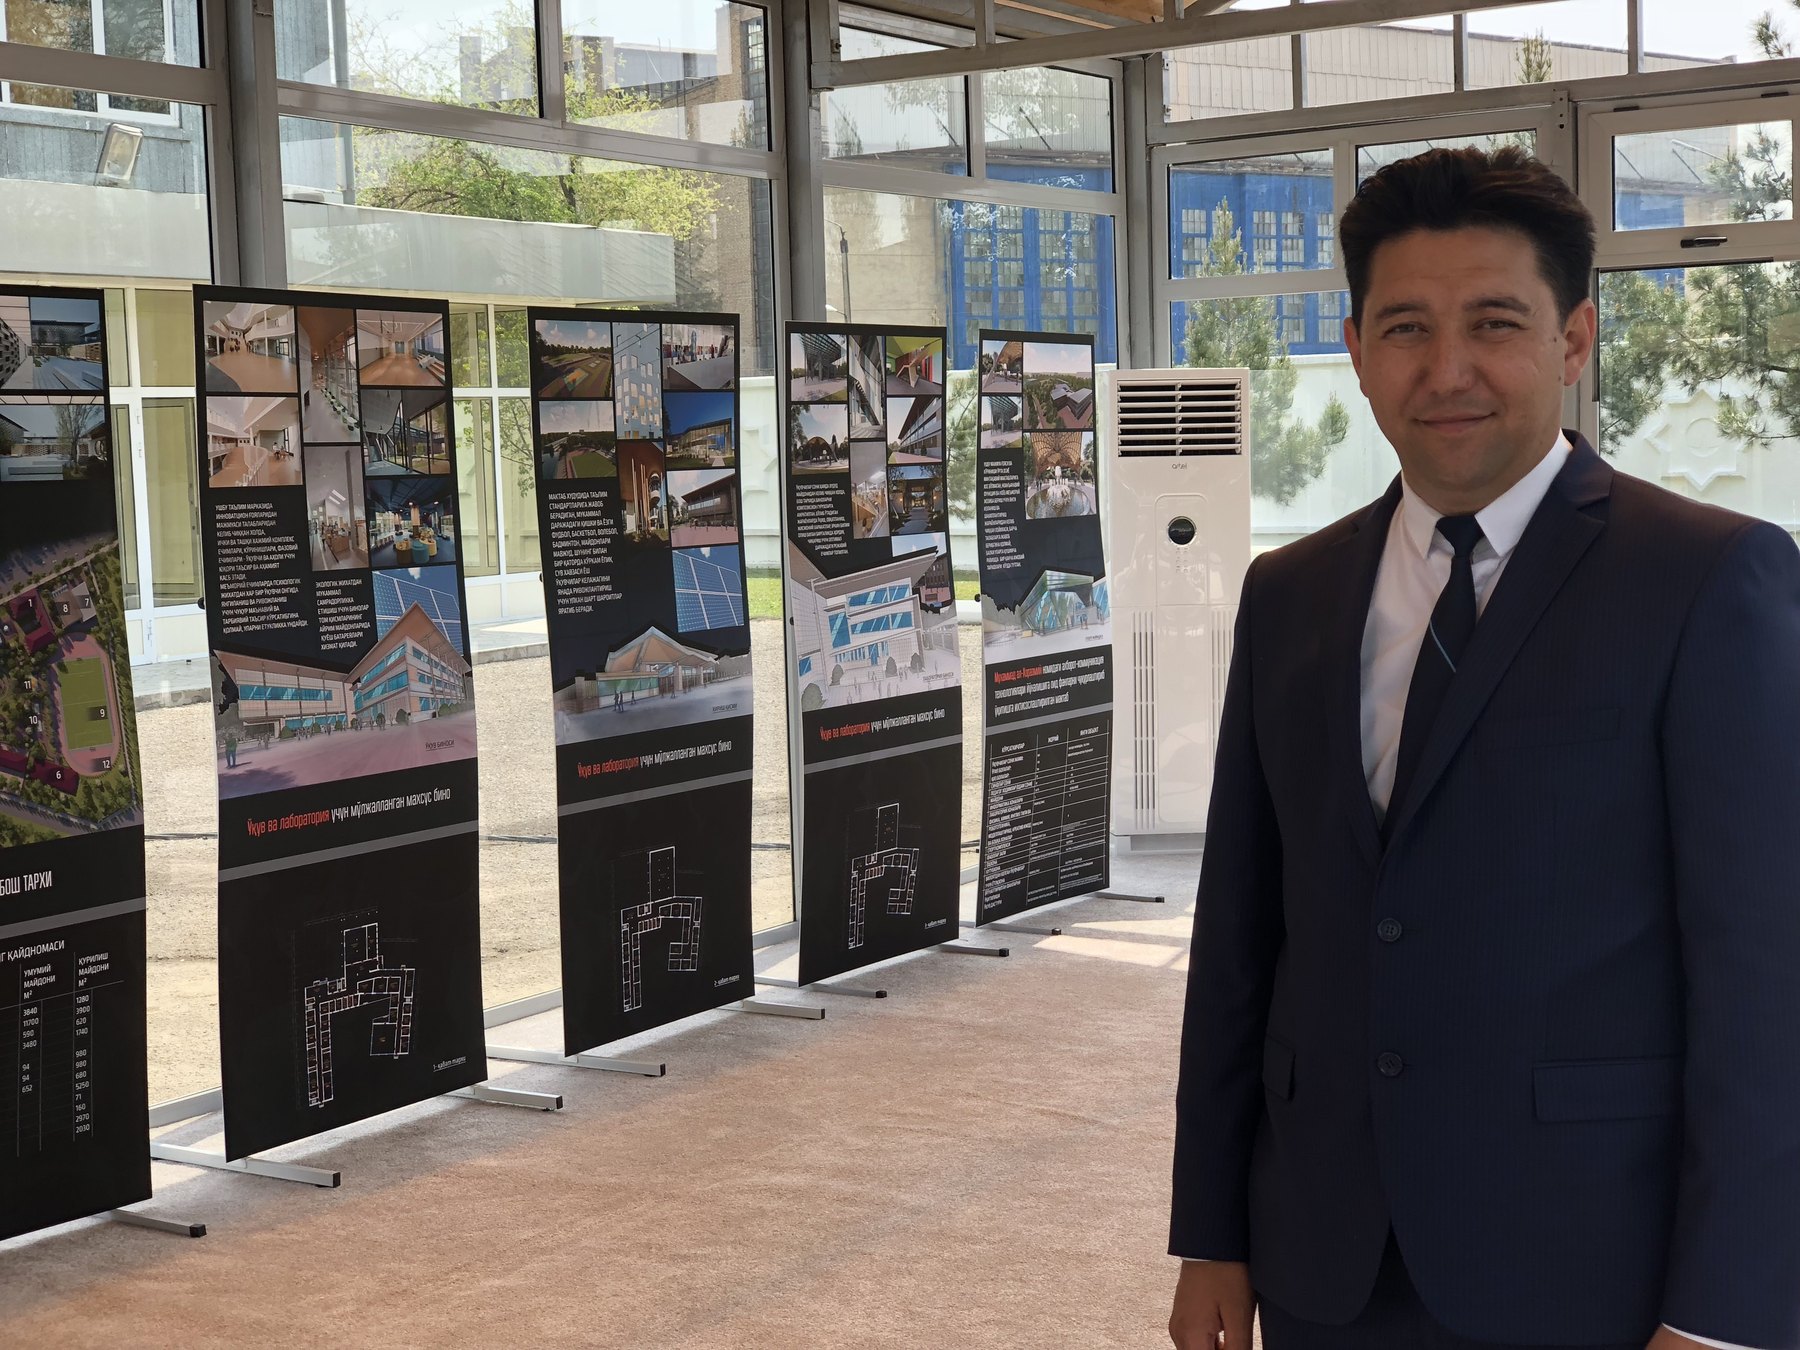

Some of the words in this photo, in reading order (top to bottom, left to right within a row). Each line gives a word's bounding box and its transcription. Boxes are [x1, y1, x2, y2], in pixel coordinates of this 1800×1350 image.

[28, 598, 33, 608] 1
[85, 598, 90, 607] 7
[62, 603, 69, 613] 8
[23, 680, 31, 689] 11
[100, 708, 105, 718] 9
[28, 715, 38, 725] 10
[833, 728, 839, 738] ва
[839, 722, 870, 736] лаборатория
[871, 720, 882, 733] учун
[934, 708, 945, 719] бино
[102, 760, 110, 769] 12
[577, 762, 592, 779] Ўқув
[593, 764, 601, 775] ва
[601, 757, 639, 773] лаборатория
[640, 754, 654, 768] учун
[654, 747, 696, 765] мўлжалланган
[697, 743, 718, 756] махсус
[718, 740, 732, 752] бино
[56, 770, 61, 779] 6
[247, 818, 265, 837] Ўқув
[267, 819, 278, 832] ва
[279, 810, 330, 830] лаборатория
[331, 806, 349, 823] учун
[350, 796, 405, 818] мўлжалланган
[406, 791, 432, 807] махсус
[433, 787, 451, 802] бино
[0, 876, 20, 896] БОШ
[23, 870, 52, 891] ТАРХИ
[8, 940, 65, 961] ҚАЙДНОМАСИ
[78, 953, 109, 965] ҚУРИЛИШ
[24, 964, 51, 978] УМУМИЙ
[78, 963, 109, 976] МАЙДОНИ
[24, 975, 56, 989] МАЙДОНИ
[76, 994, 90, 1004] 1280
[23, 1007, 38, 1016] 3840
[76, 1005, 91, 1015] 3900
[23, 1018, 39, 1027] 11700
[76, 1017, 87, 1026] 620
[23, 1029, 34, 1038] 590
[76, 1027, 88, 1036] 1740
[22, 1040, 37, 1050] 3480
[76, 1049, 87, 1058] 980
[76, 1060, 87, 1068] 980
[22, 1074, 30, 1082] 94
[75, 1071, 87, 1079] 680
[22, 1084, 33, 1093] 652
[75, 1081, 89, 1091] 5250
[76, 1103, 86, 1112] 160
[76, 1113, 90, 1123] 2970
[76, 1124, 90, 1133] 2030
